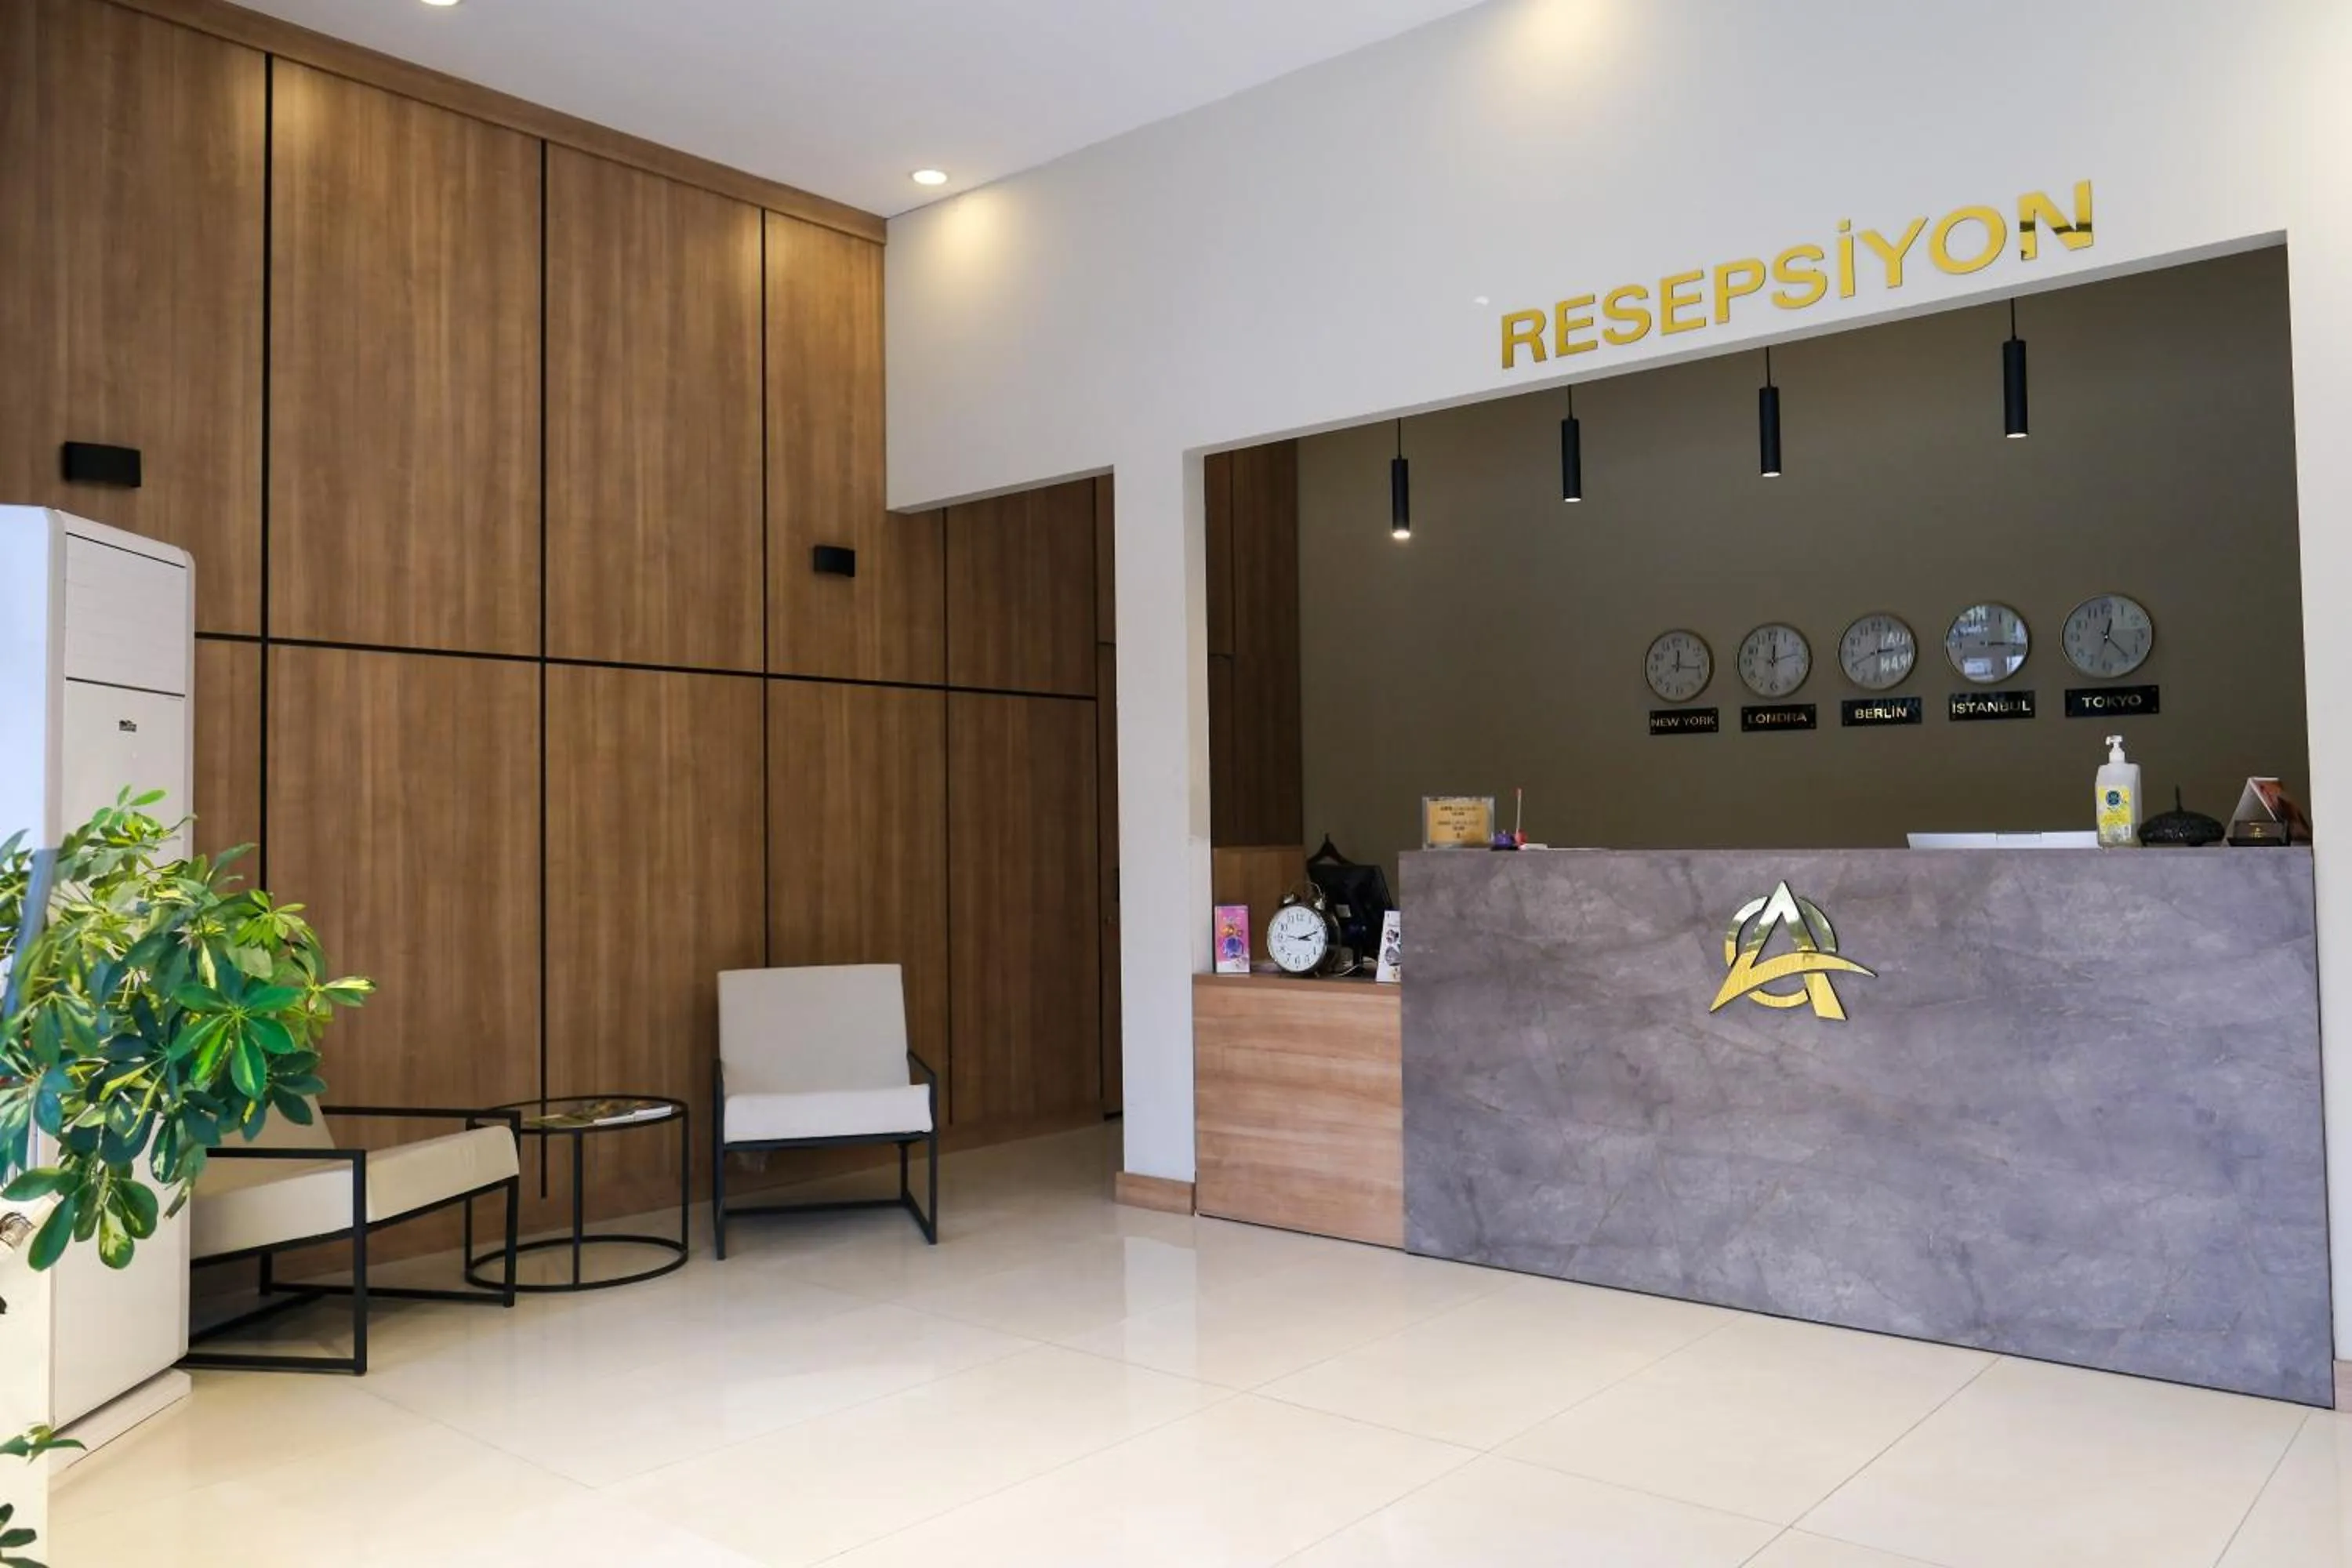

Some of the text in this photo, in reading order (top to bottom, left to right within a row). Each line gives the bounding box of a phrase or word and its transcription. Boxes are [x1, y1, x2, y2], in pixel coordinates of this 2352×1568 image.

[1501, 180, 2093, 368] RESEPSİYON
[2082, 695, 2142, 708] TOKYO
[1650, 715, 1715, 728] NEW YORK
[1748, 713, 1808, 724] LONDRA
